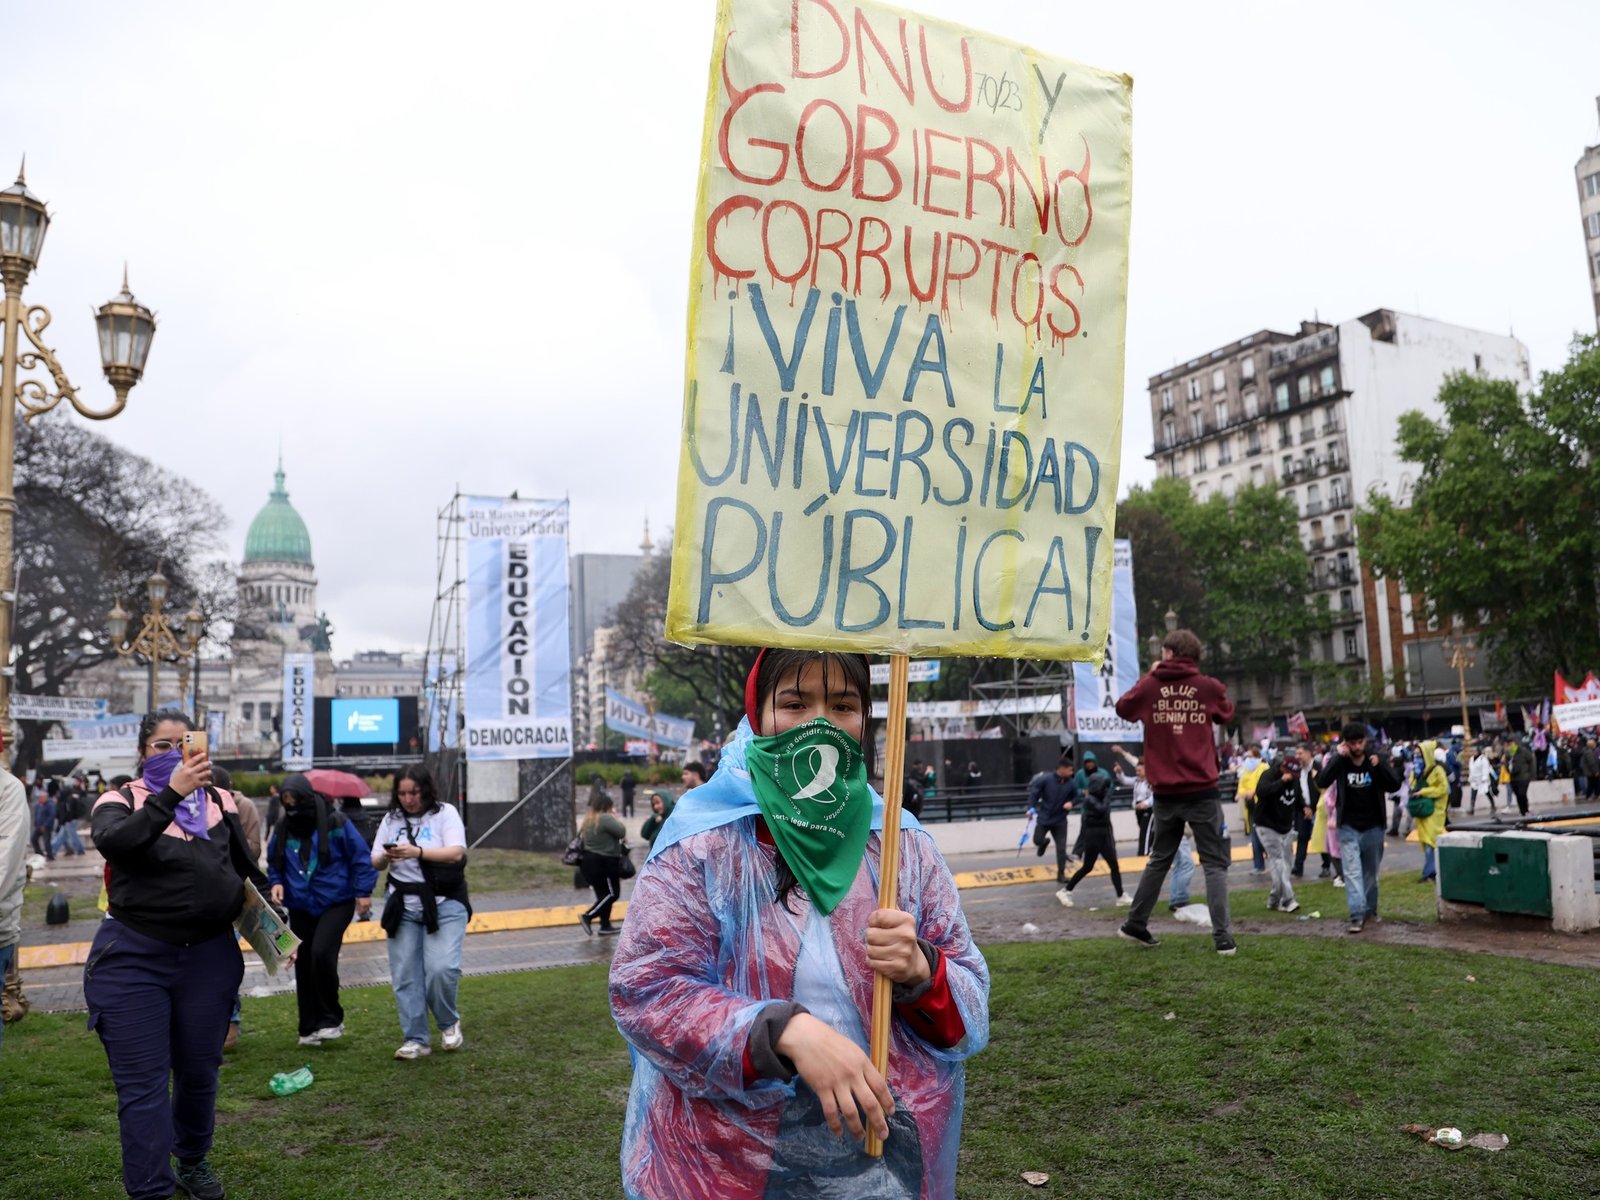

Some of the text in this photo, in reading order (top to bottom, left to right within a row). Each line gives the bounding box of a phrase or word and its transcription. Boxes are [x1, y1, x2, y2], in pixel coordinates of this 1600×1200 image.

[791, 0, 1067, 145] DNU 70/23 Y
[718, 31, 1093, 248] GOBIERNO
[707, 194, 1089, 342] CORRUPTOS.
[993, 343, 1047, 419] LA
[470, 519, 564, 538] Universitaria
[507, 543, 529, 715] EDUCACION
[1160, 684, 1198, 699] BLUE
[291, 667, 304, 757] EDUCACION
[1158, 699, 1199, 711] BLOOD
[1153, 711, 1207, 724] DENIM CO
[469, 727, 569, 746] DEMOCRACIA
[1347, 772, 1372, 785] FUA
[790, 817, 809, 828] legal
[810, 824, 828, 833] para
[828, 826, 837, 834] no
[974, 867, 1035, 883] MUERTE
